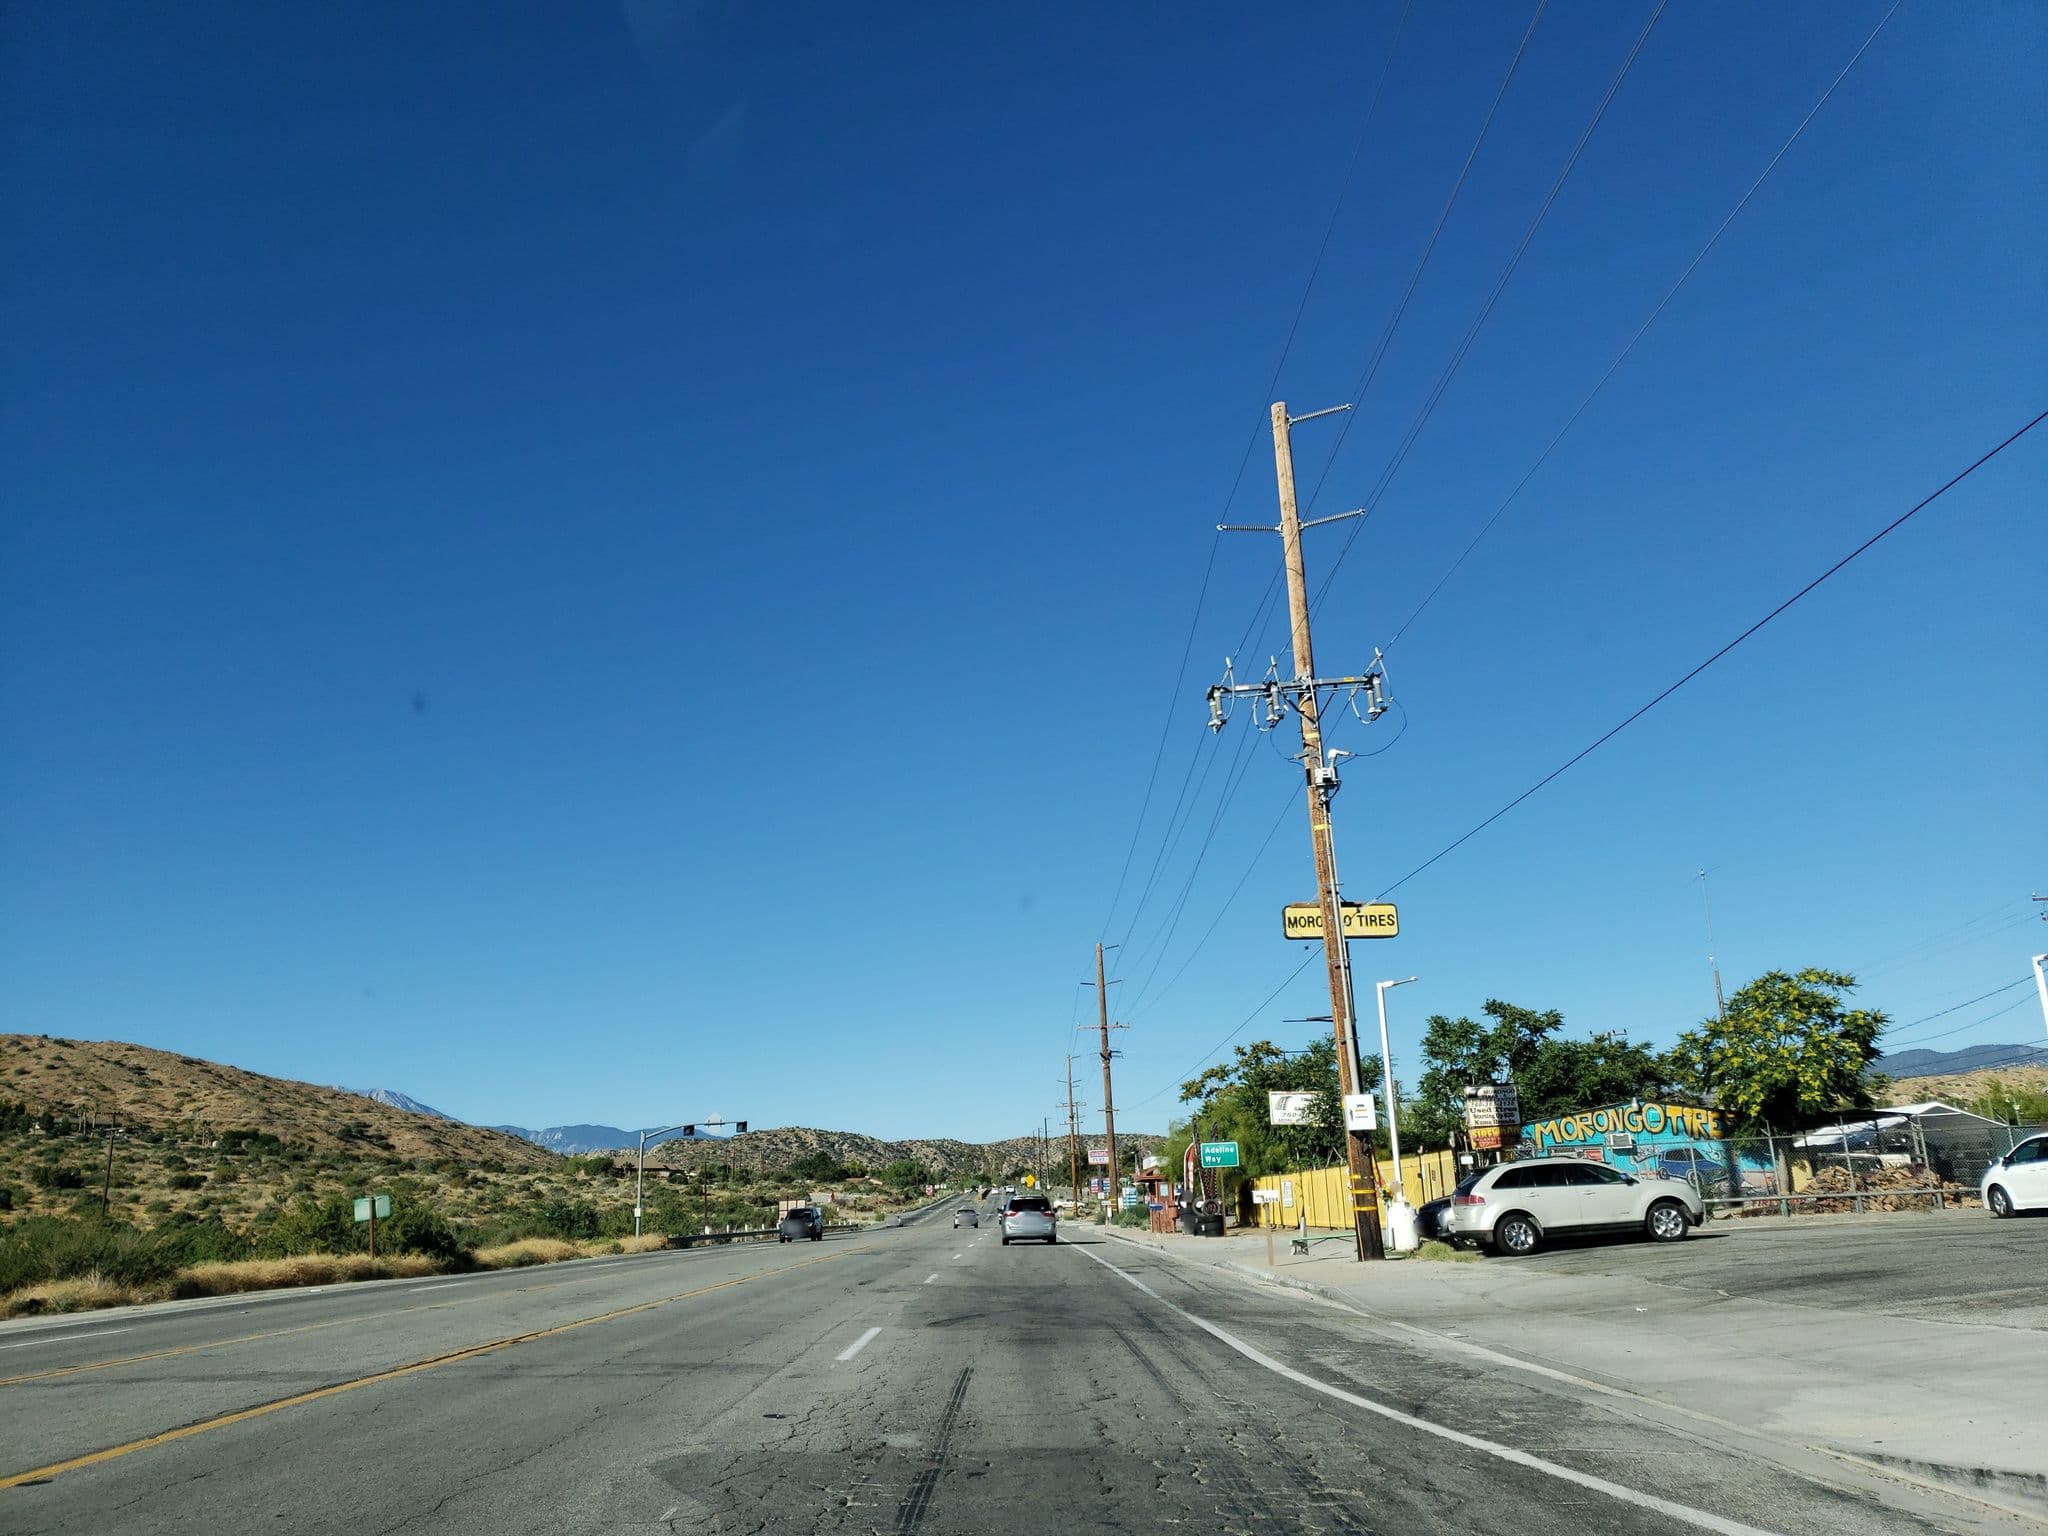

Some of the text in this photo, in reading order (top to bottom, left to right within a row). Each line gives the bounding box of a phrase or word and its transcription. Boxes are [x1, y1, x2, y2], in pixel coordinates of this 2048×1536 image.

[1287, 914, 1396, 928] MOROO TIRES
[1534, 1102, 1666, 1151] MORONGO
[1204, 1146, 1234, 1154] Adeline
[1204, 1155, 1221, 1164] Way
